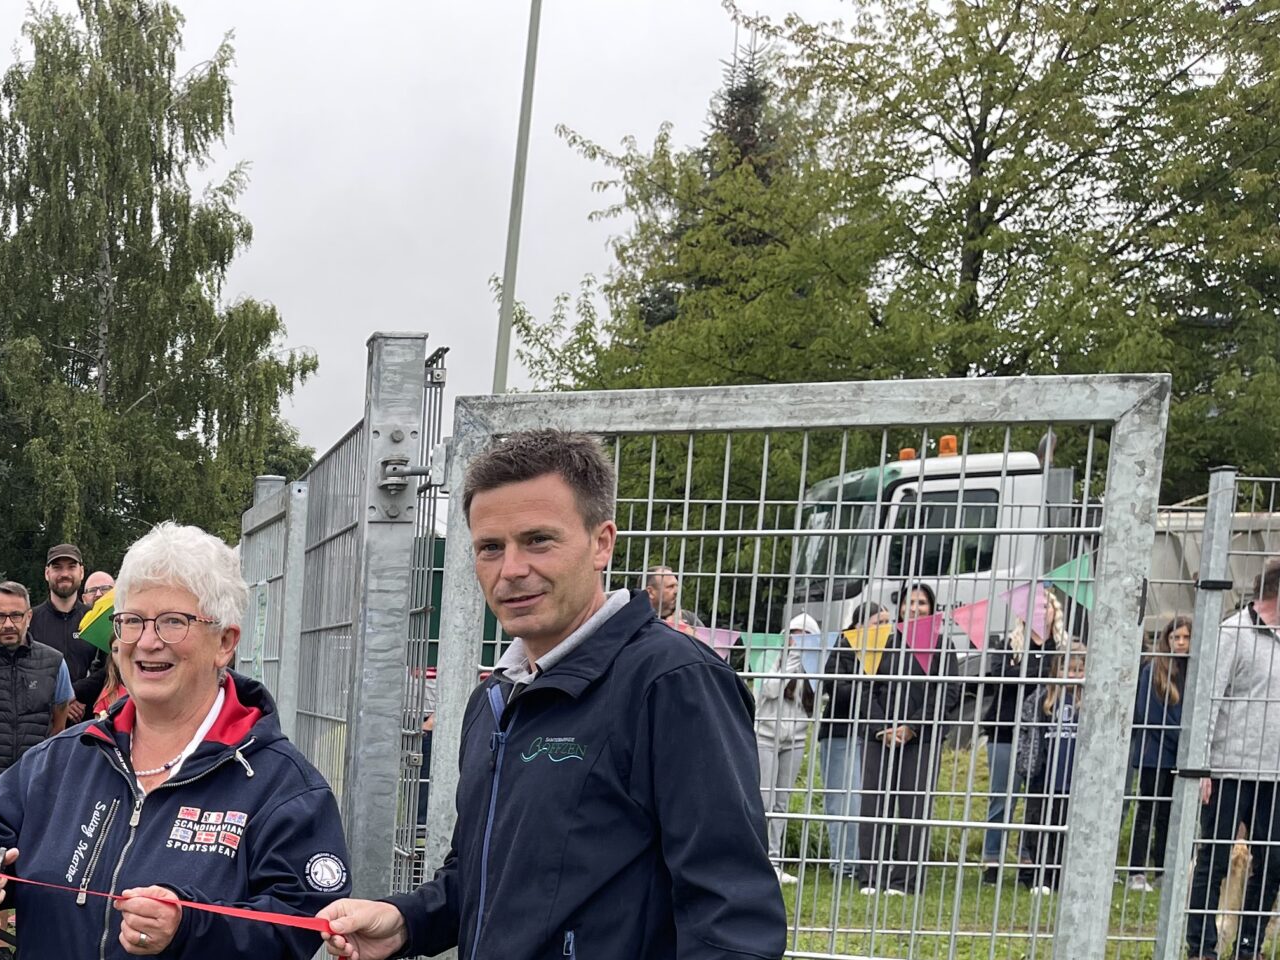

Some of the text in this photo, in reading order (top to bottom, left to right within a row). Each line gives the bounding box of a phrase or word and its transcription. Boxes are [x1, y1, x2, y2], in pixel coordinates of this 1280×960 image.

[66, 801, 107, 883] Sailing Marine
[173, 819, 244, 836] SCANDINAVIAN
